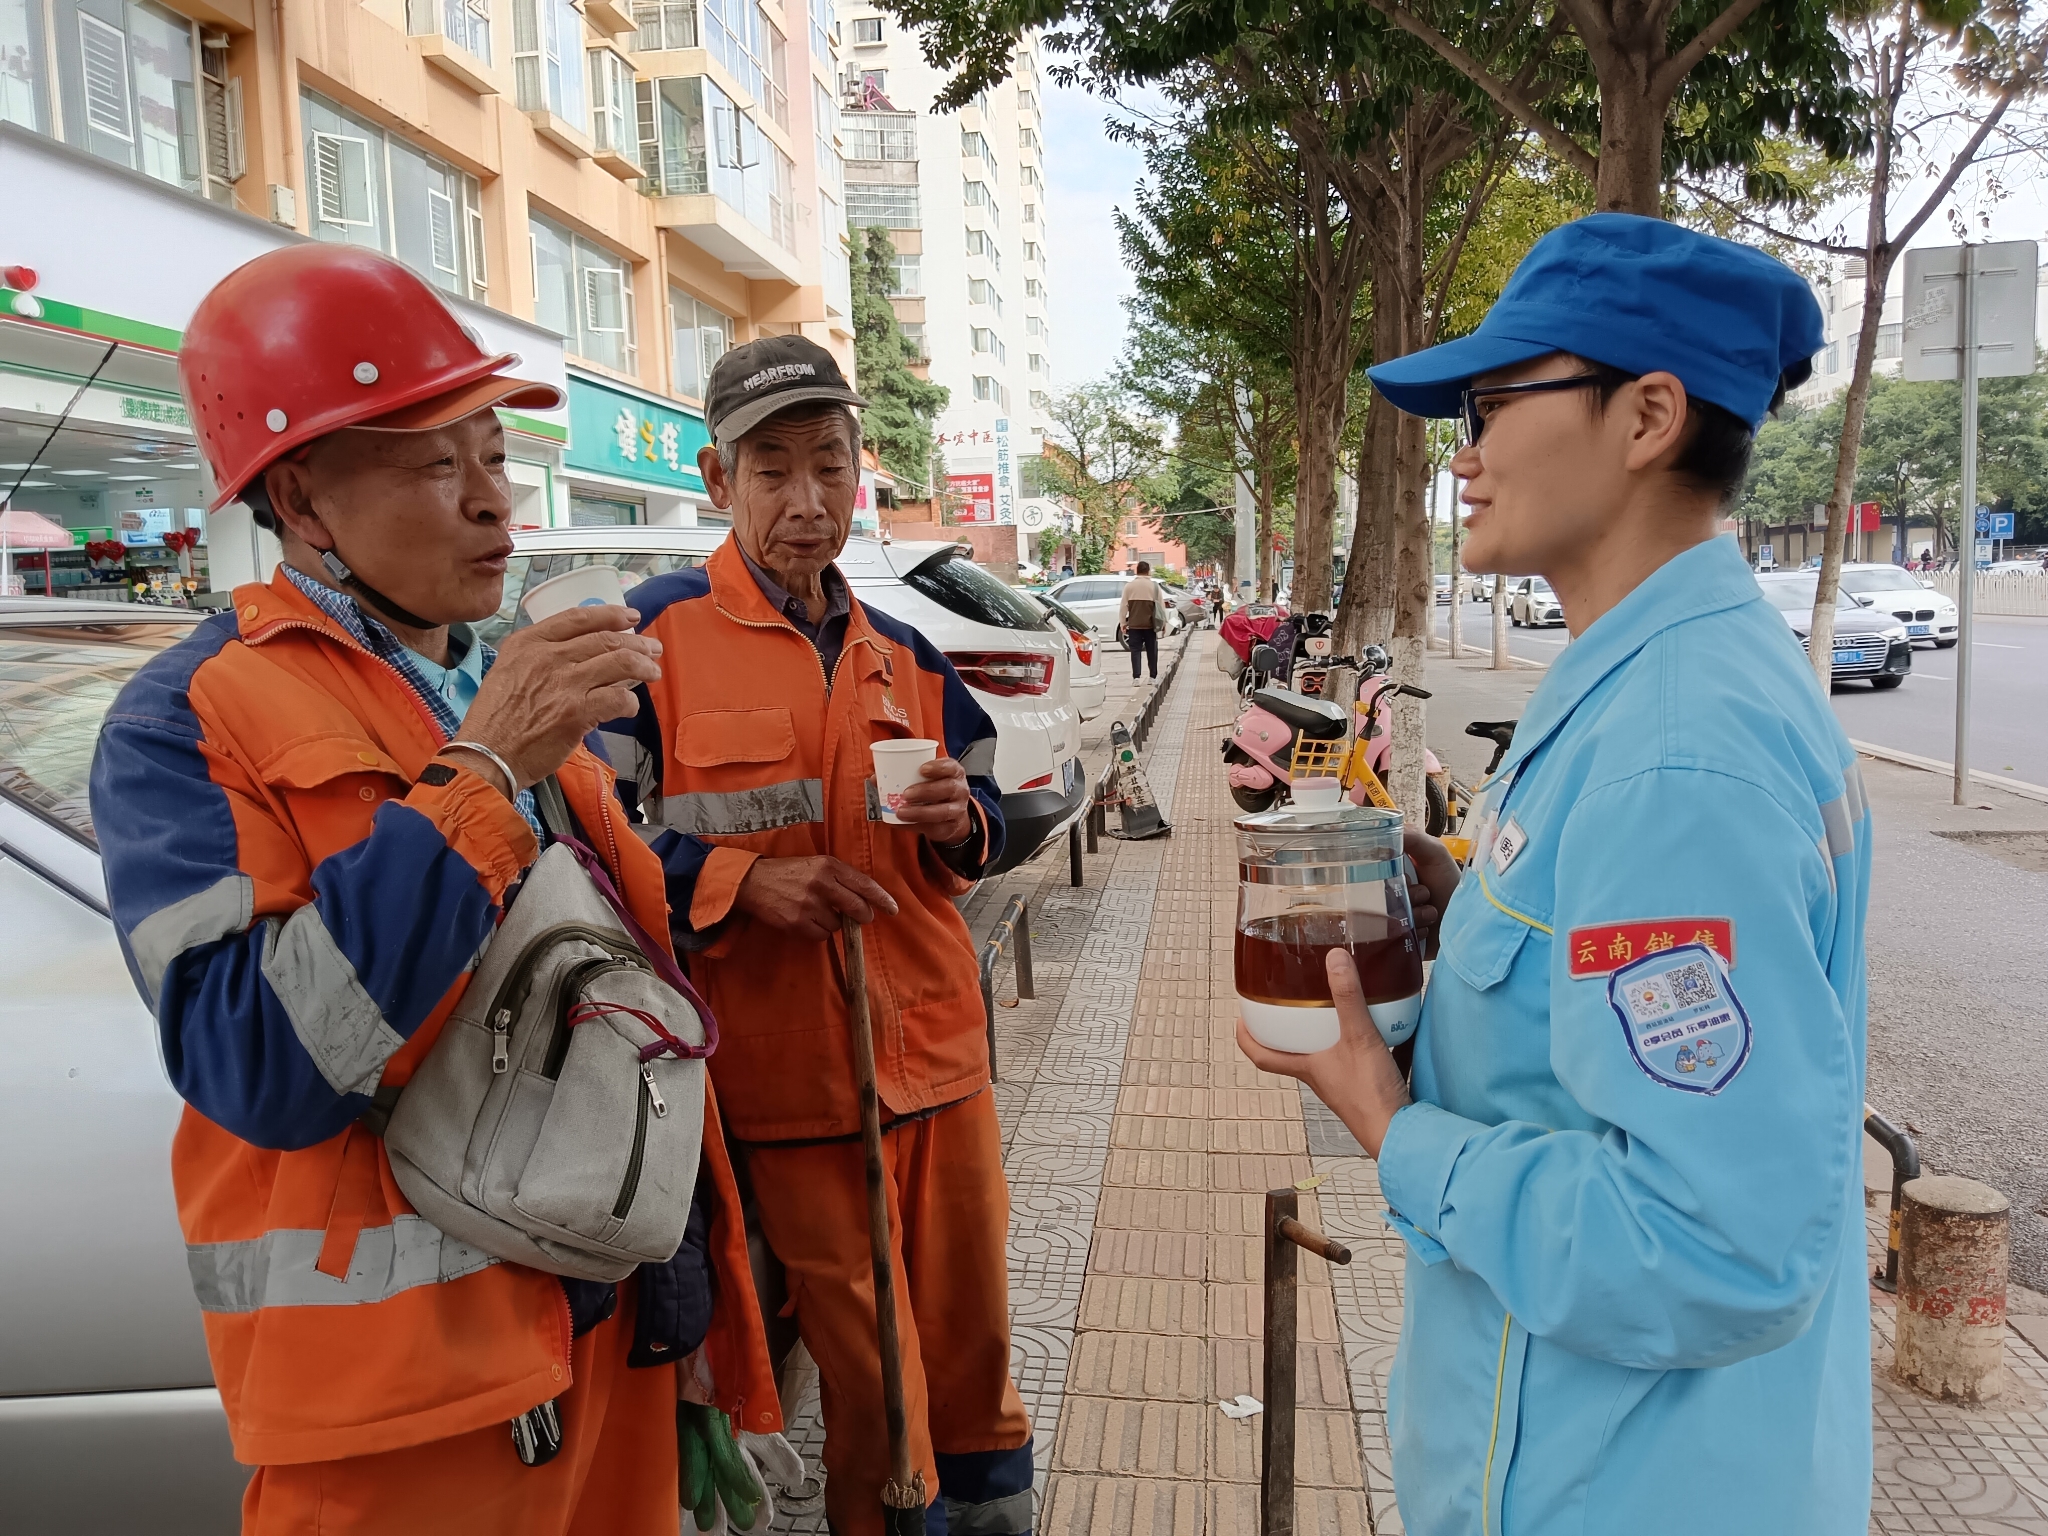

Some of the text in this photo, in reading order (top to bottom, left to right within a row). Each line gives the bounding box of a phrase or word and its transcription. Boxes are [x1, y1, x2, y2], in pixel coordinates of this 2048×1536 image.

[743, 363, 816, 391] HEARFROM
[996, 435, 1011, 488] 松筋推拿
[1995, 517, 2009, 533] P
[1126, 764, 1146, 805] 禁止停车
[1364, 780, 1381, 797] 美团
[1643, 1012, 1732, 1047] e享会员 乐享油惠
